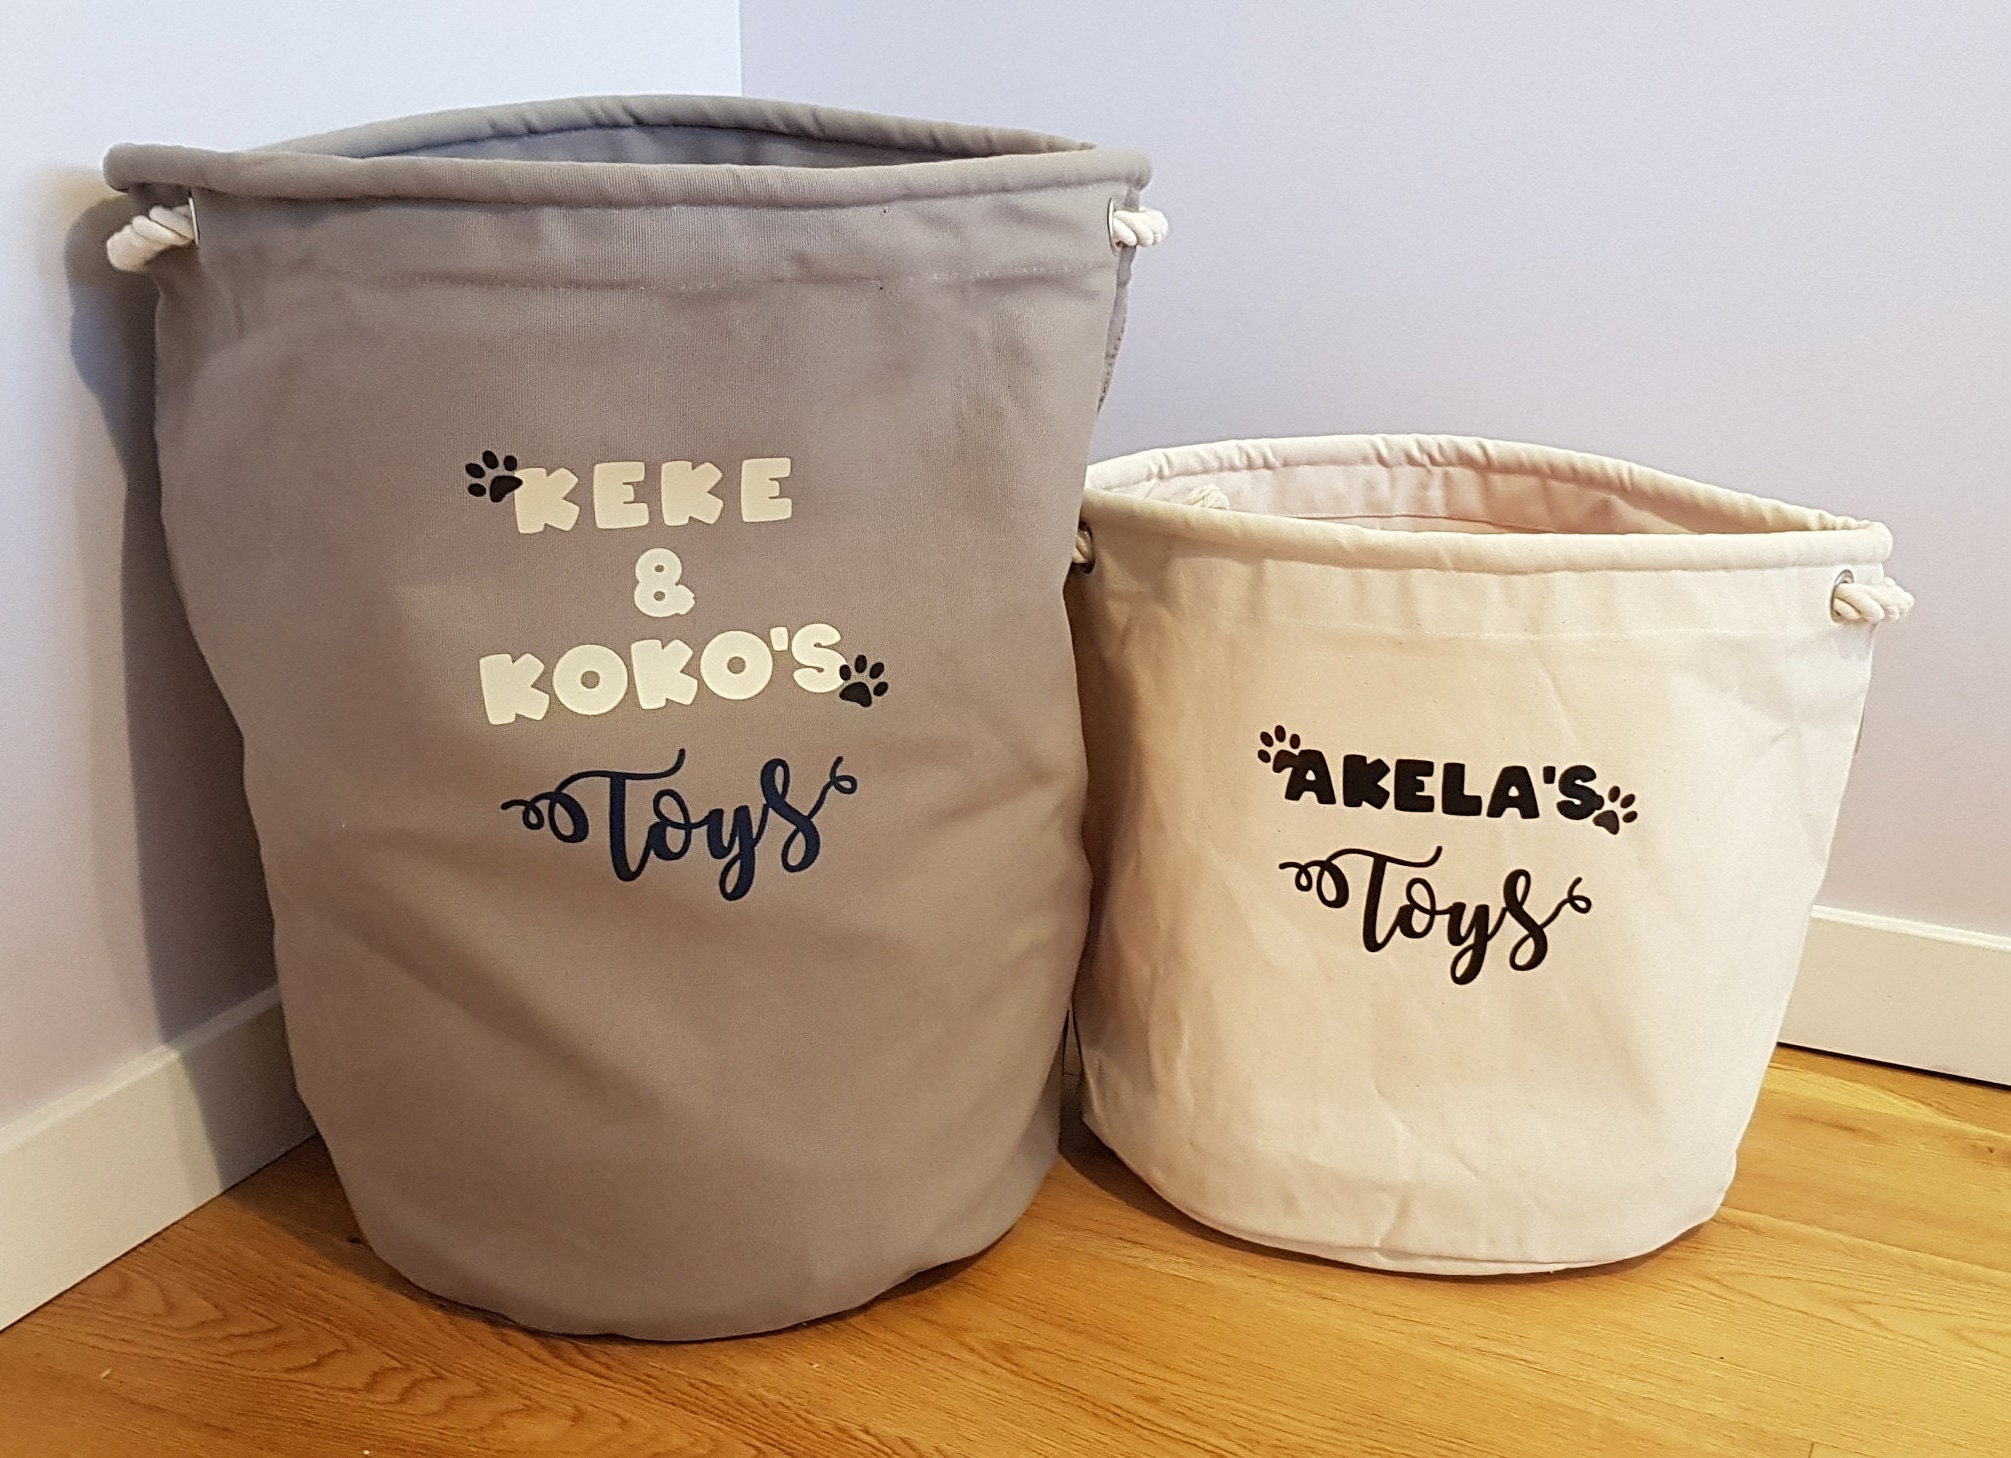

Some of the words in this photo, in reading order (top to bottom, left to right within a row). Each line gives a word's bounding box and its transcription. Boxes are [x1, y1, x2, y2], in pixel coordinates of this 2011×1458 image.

[514, 457, 793, 534] KEKE
[634, 547, 696, 618] &
[479, 623, 847, 725] KOKO'S
[500, 748, 858, 901] Toys
[1284, 749, 1600, 820] AKELA'S
[1278, 846, 1592, 985] Toys
